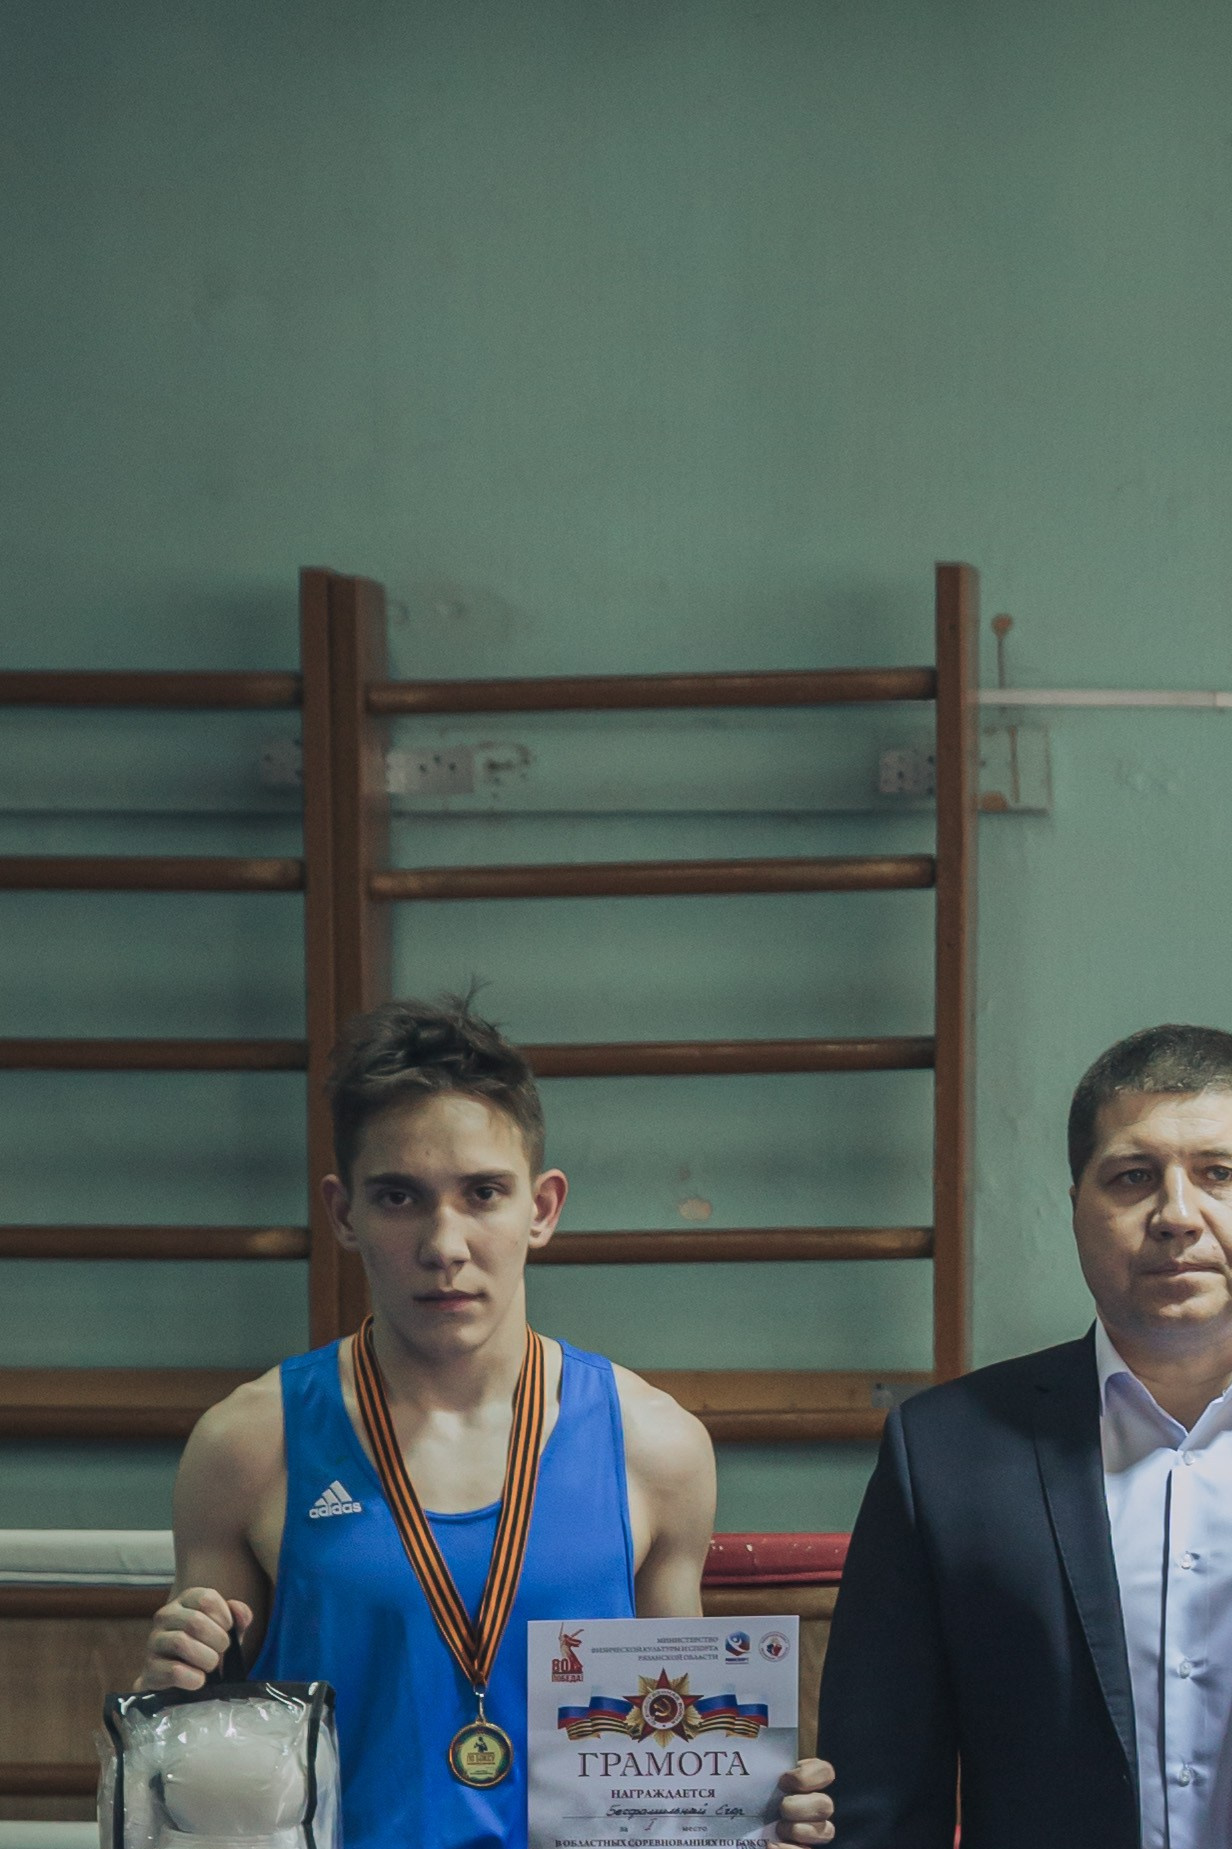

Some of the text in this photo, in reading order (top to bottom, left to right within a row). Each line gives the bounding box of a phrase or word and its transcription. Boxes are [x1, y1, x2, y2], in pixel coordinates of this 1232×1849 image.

[309, 1502, 362, 1519] adidas
[577, 1750, 750, 1777] ГРАМОТА
[611, 1788, 716, 1799] НАГРАЖДАЕТСЯ
[562, 1839, 628, 1848] ОБЛАСТНЫХ
[628, 1838, 719, 1847] СОРЕВНОВАНИЯХ
[719, 1838, 734, 1847] ПО
